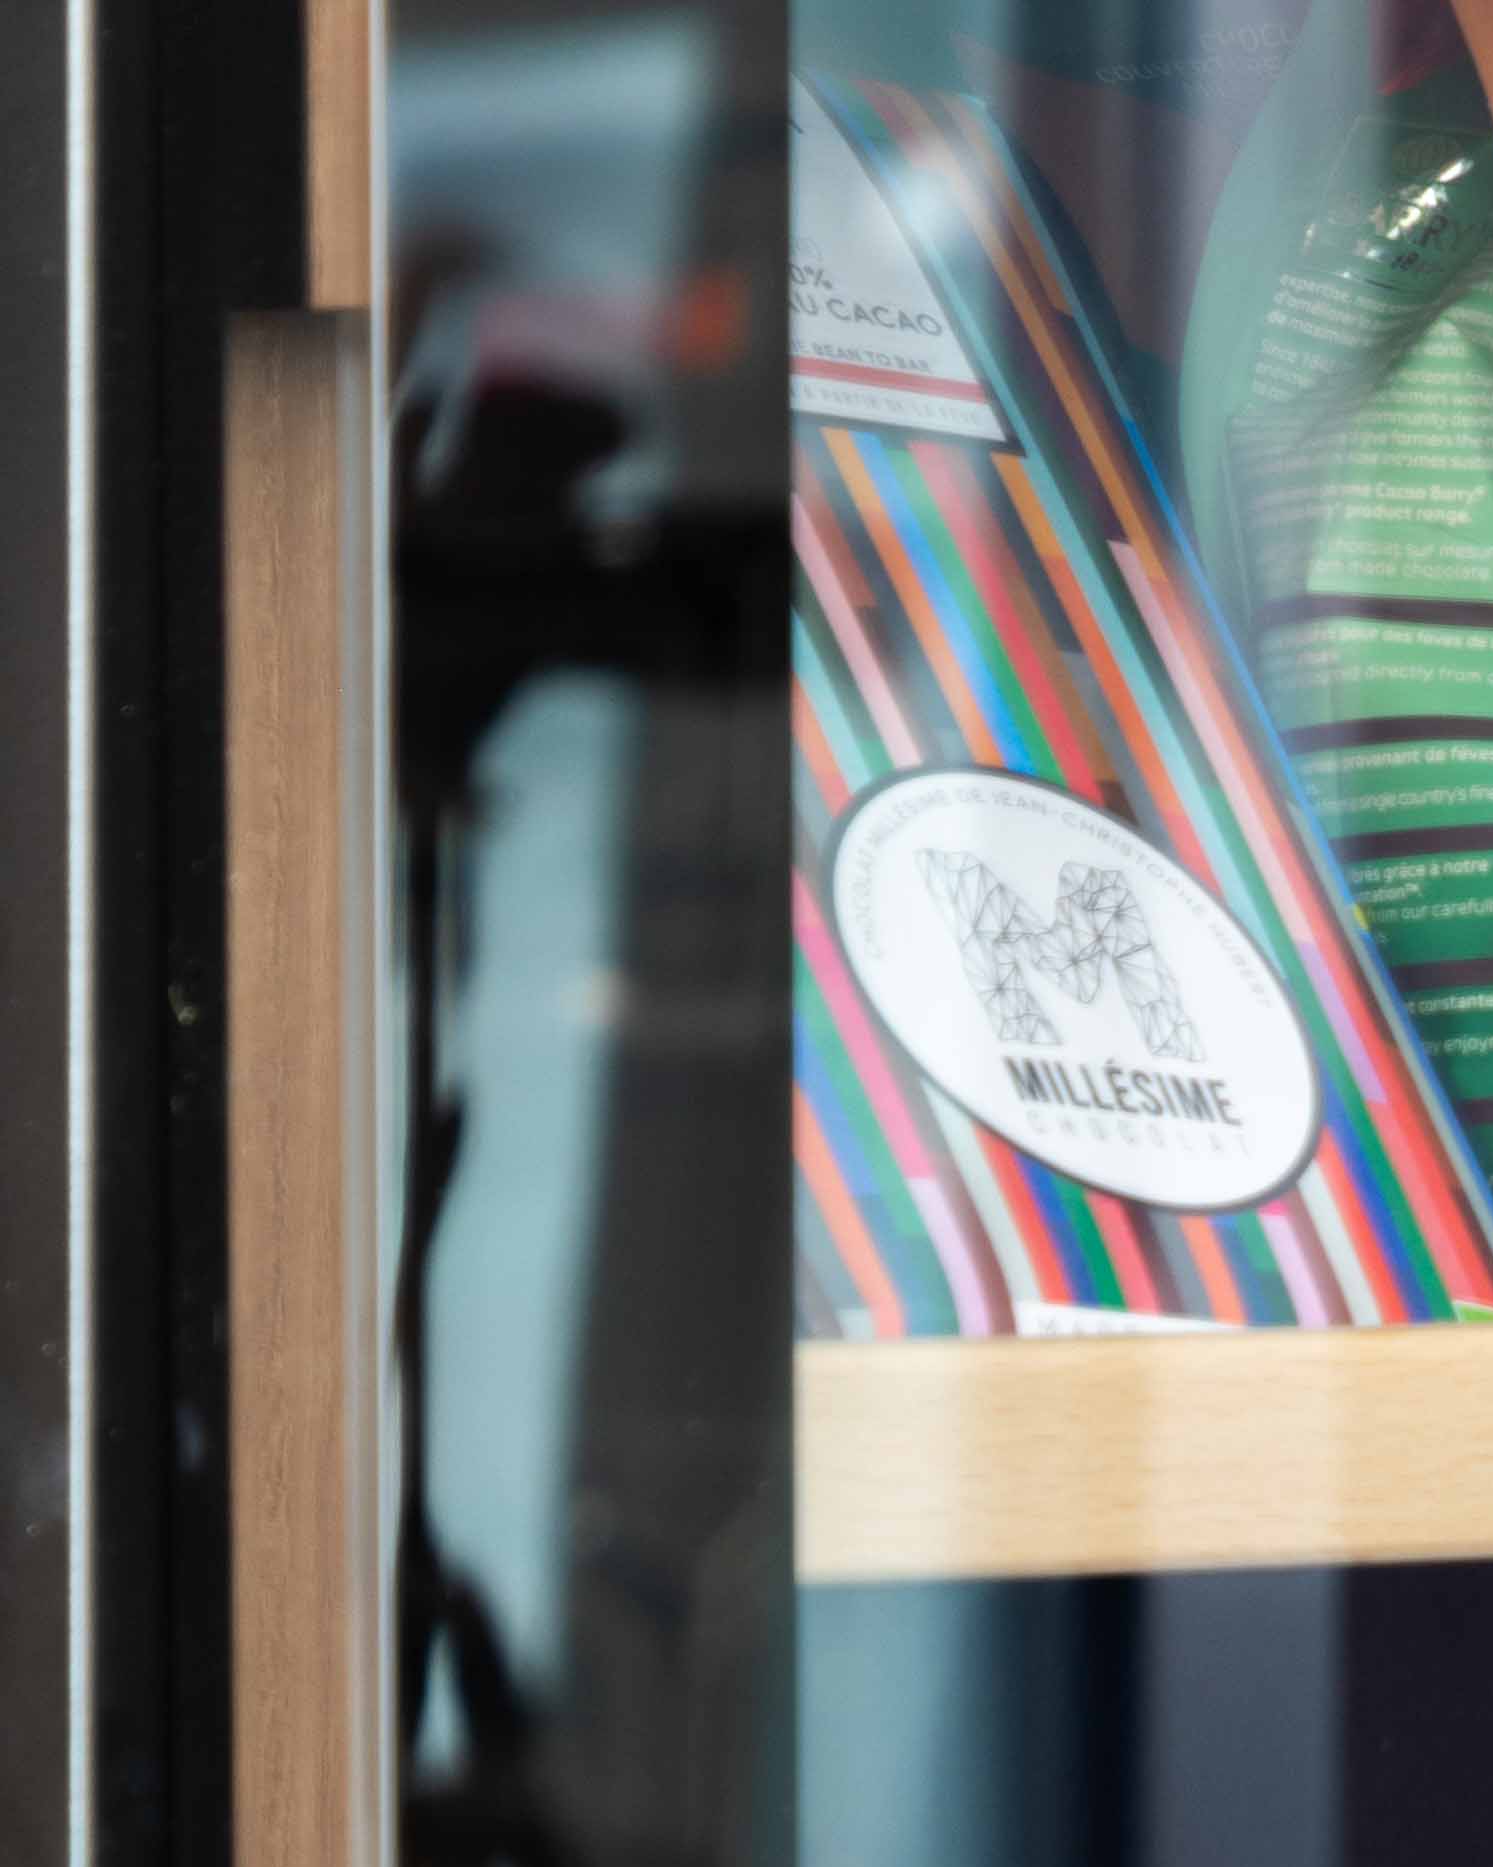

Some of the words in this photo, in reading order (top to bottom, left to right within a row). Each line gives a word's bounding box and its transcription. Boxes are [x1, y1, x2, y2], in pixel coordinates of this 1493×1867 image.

[825, 298, 943, 336] CACAO
[1442, 857, 1490, 875] notre
[1003, 1055, 1244, 1127] MILLÉSIME
